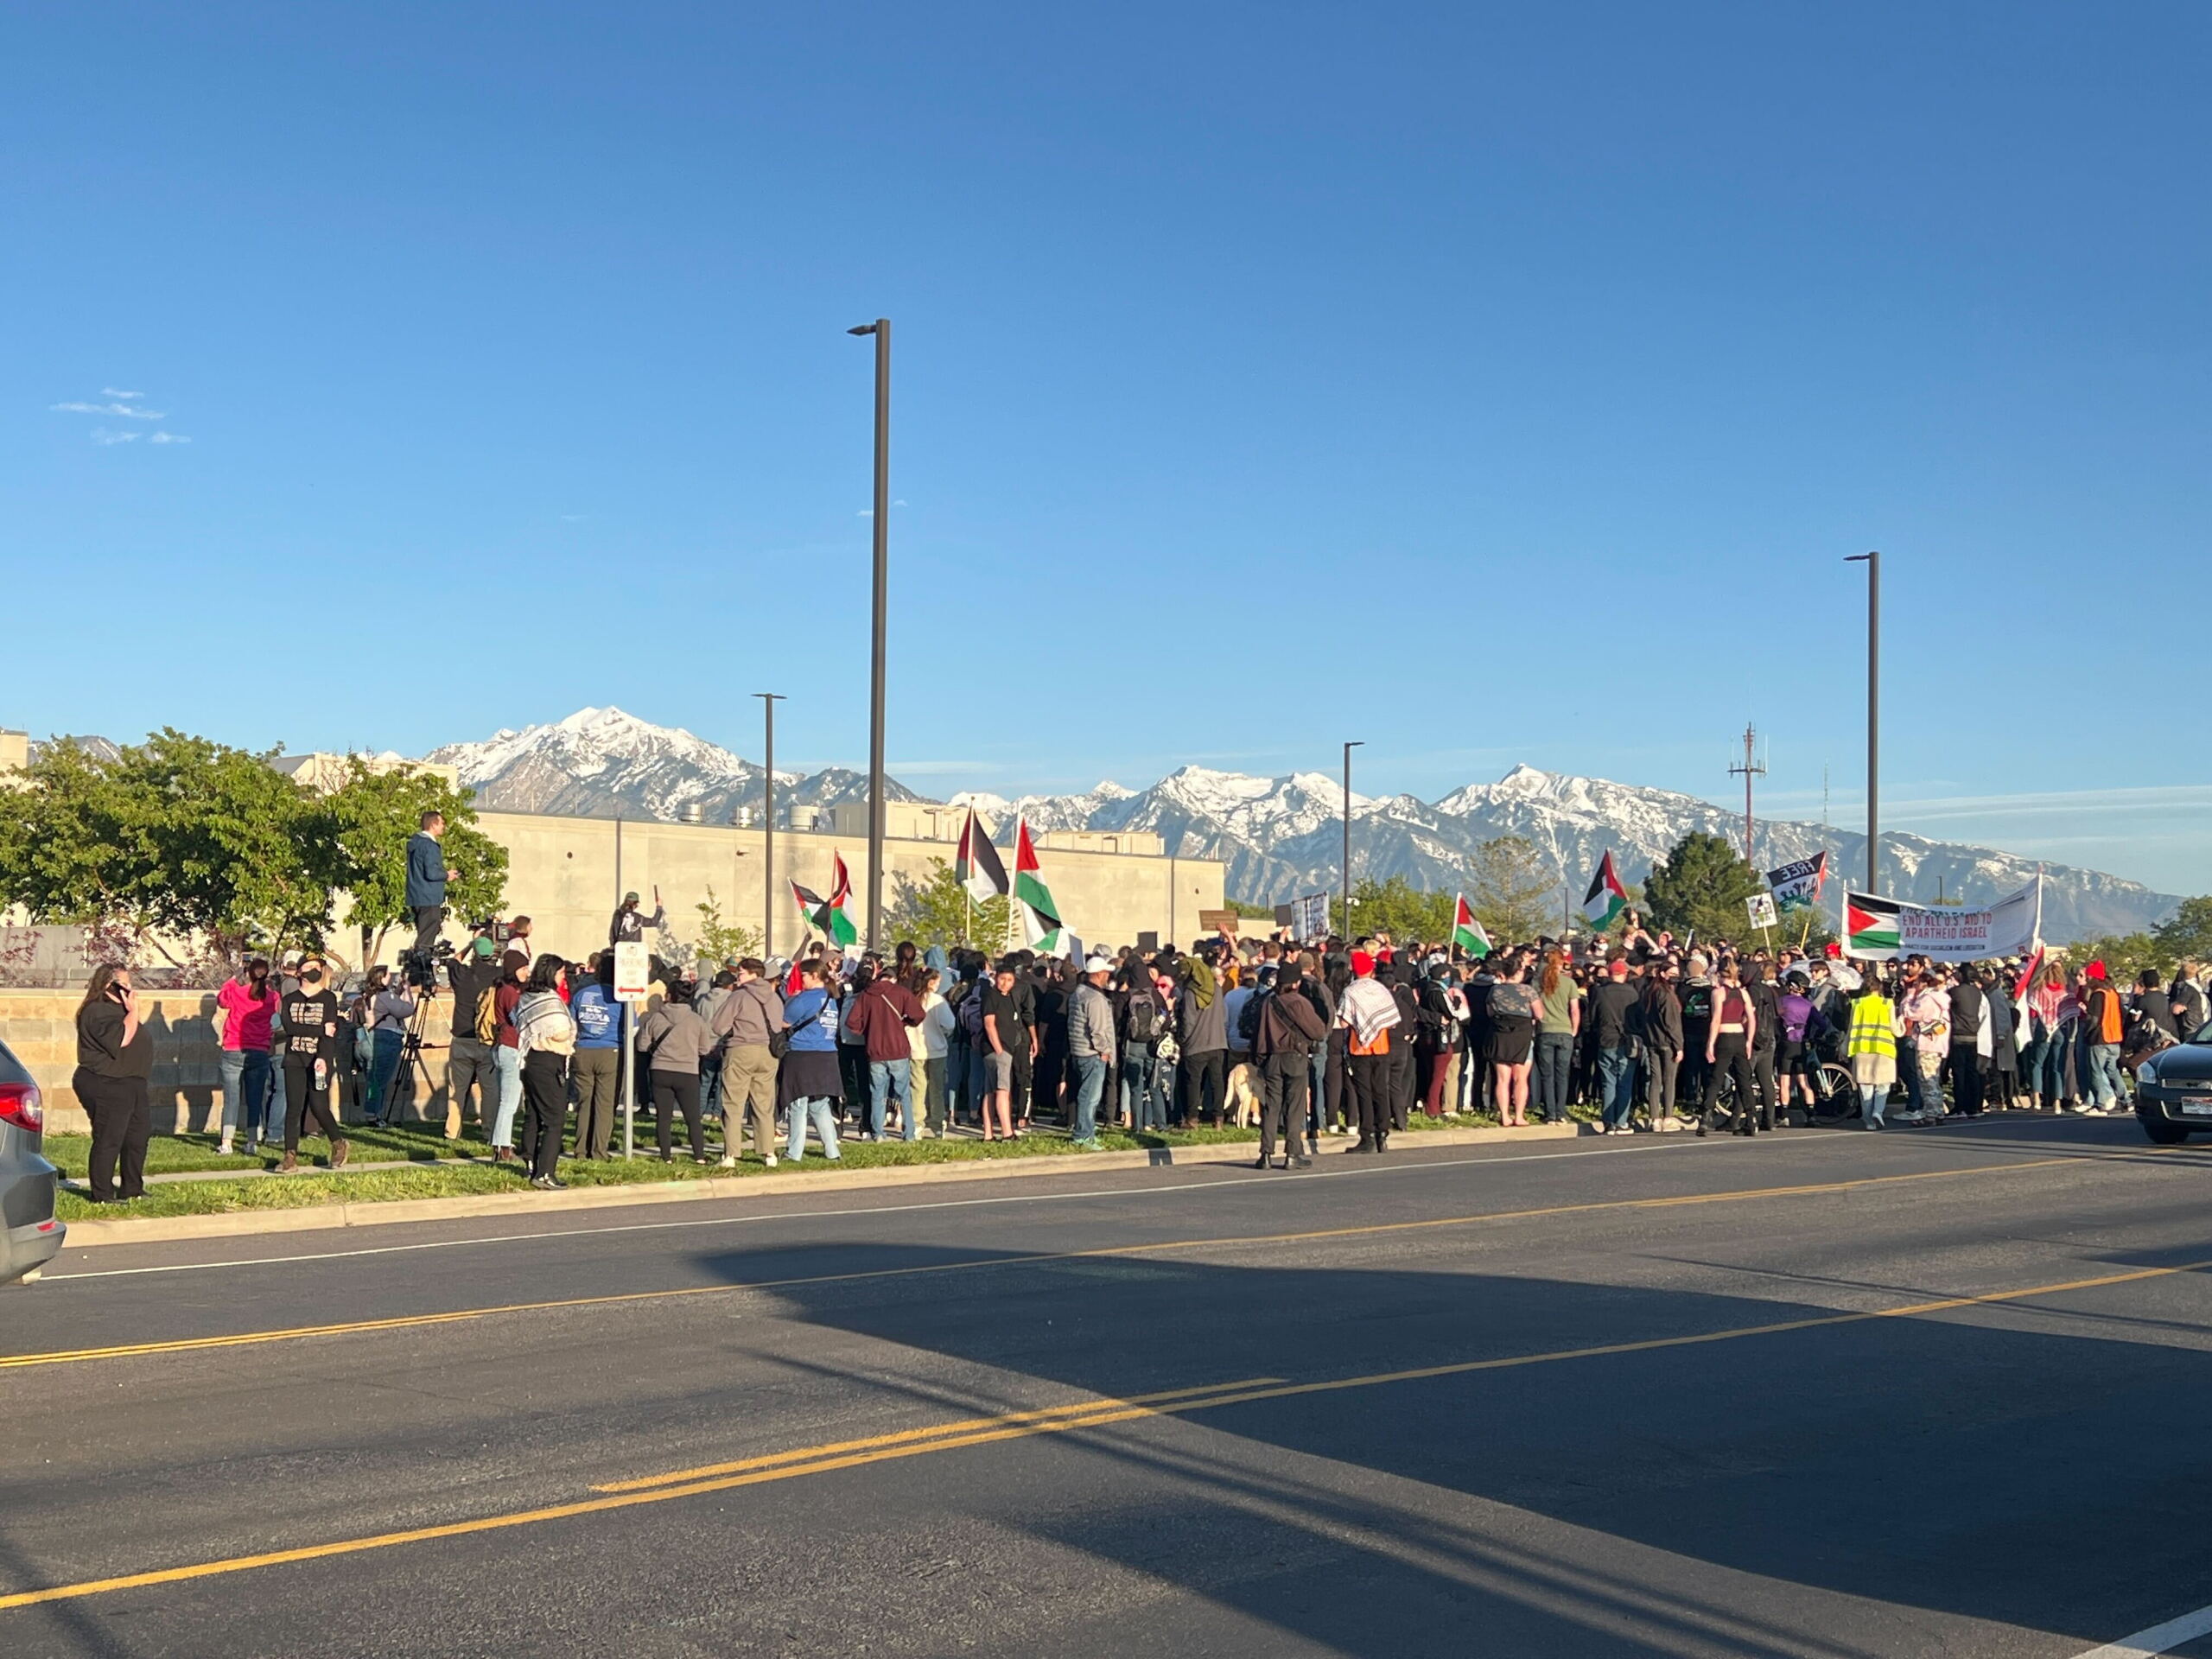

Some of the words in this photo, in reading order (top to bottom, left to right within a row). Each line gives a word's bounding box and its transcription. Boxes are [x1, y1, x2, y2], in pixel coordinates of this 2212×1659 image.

[1903, 915, 1922, 926] END
[1925, 915, 1942, 927] ALL
[1964, 913, 1979, 925] AID
[1982, 912, 1993, 925] TO
[1904, 927, 1956, 939] APARTHEID
[1959, 926, 1987, 938] ISRAEL
